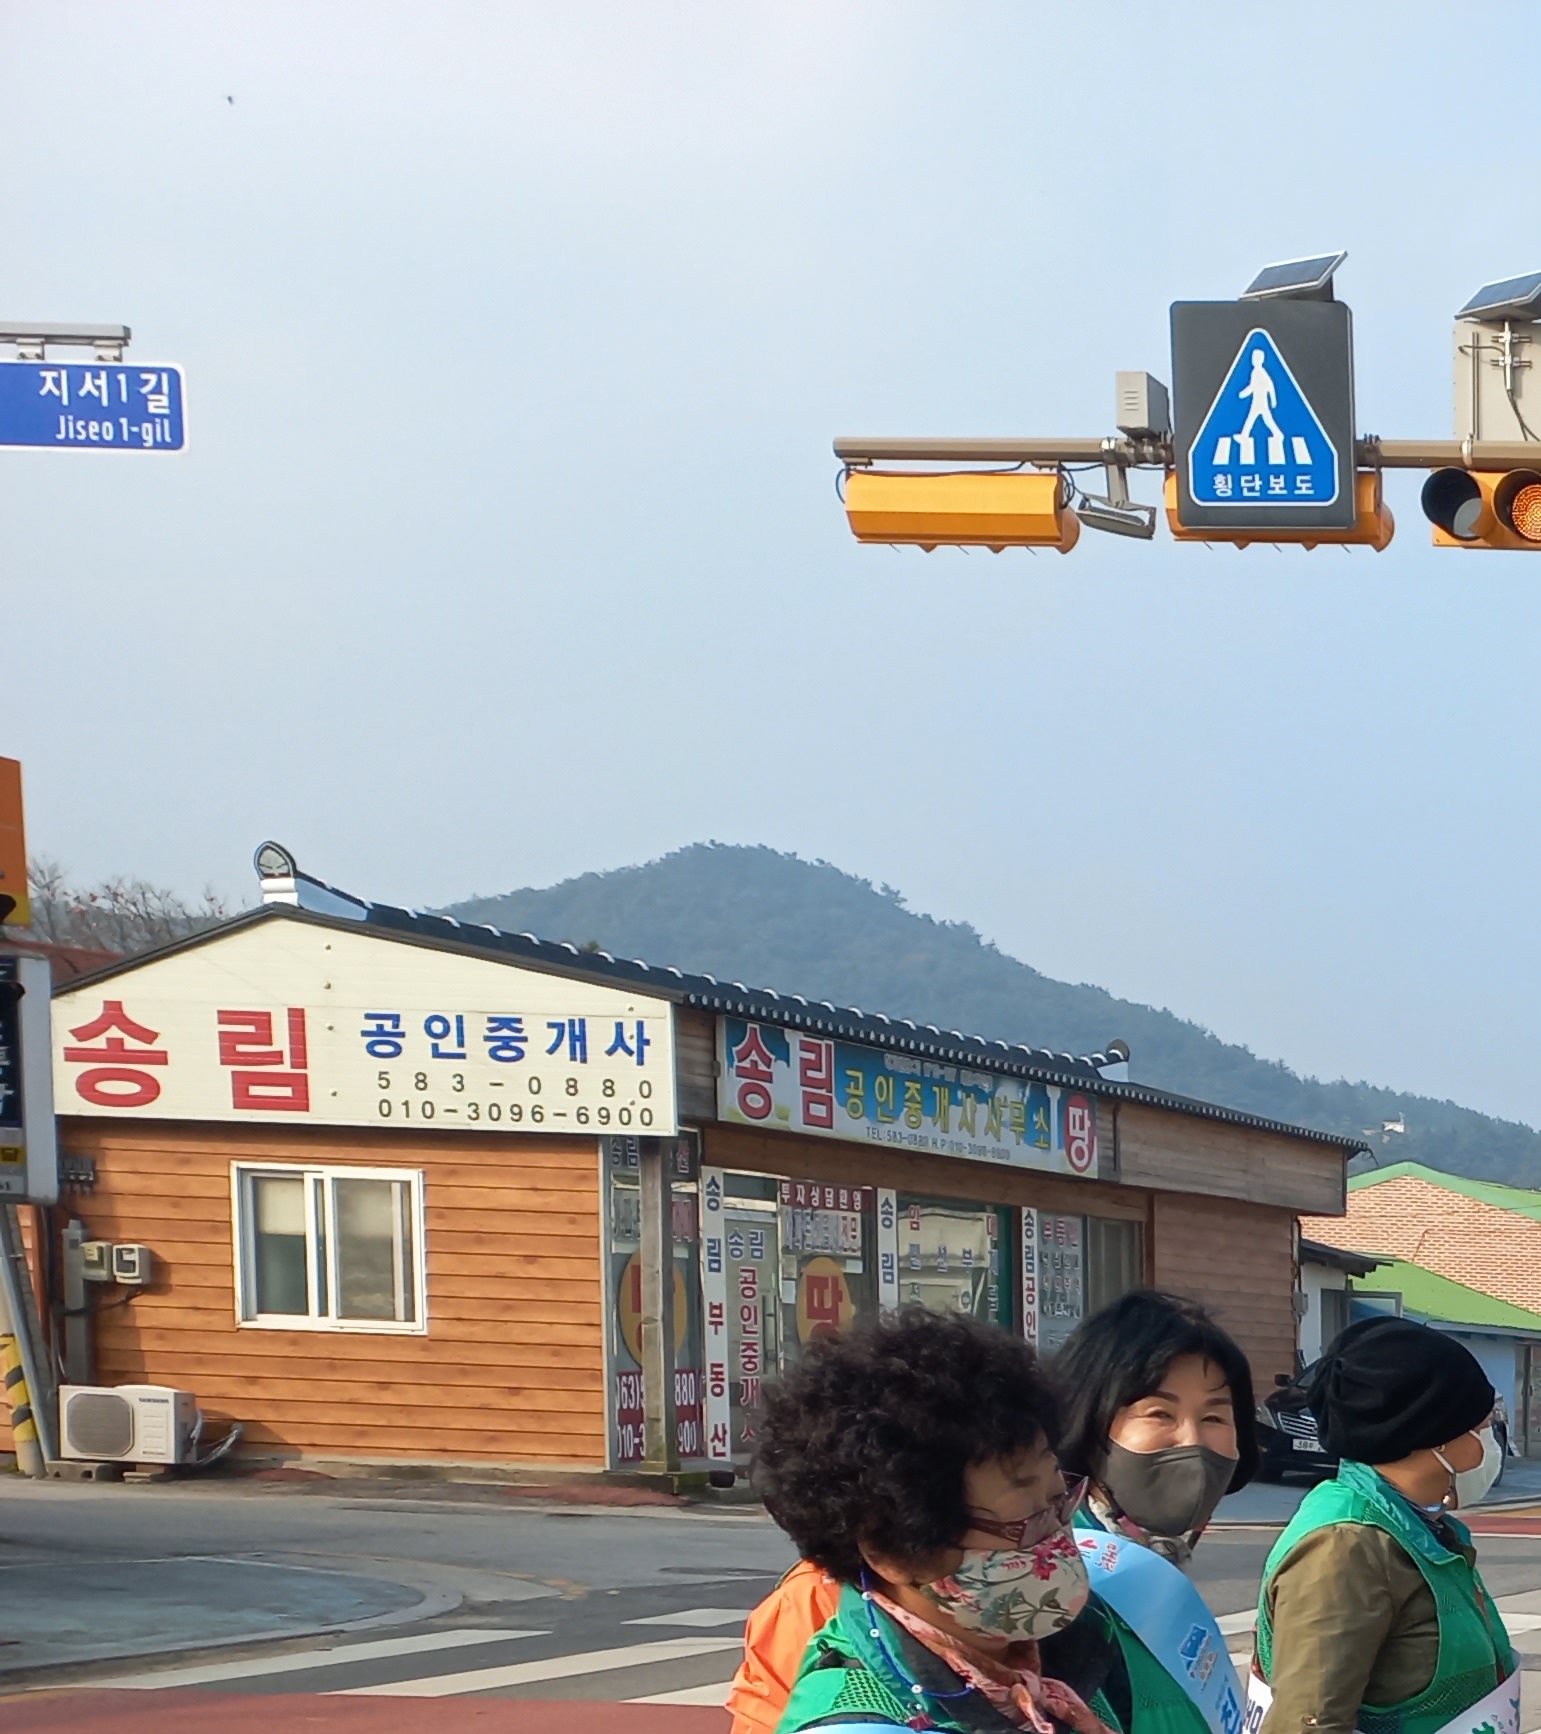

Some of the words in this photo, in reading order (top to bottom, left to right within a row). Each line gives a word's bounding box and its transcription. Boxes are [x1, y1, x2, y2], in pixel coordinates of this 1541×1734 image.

[38, 369, 171, 415] 지서1길
[56, 414, 114, 441] Jiseo
[119, 417, 173, 446] 1-gil
[1211, 473, 1316, 499] 횡단보도
[360, 1011, 652, 1067] 공인중개사
[63, 1000, 311, 1113] 송림
[377, 1070, 655, 1100] 583-0880
[732, 1022, 835, 1131] 송림
[844, 1069, 1053, 1150] 공인중개사사무소
[1066, 1105, 1092, 1171] 땅
[378, 1099, 655, 1128] 010-3096-6900
[727, 1228, 765, 1260] 송림
